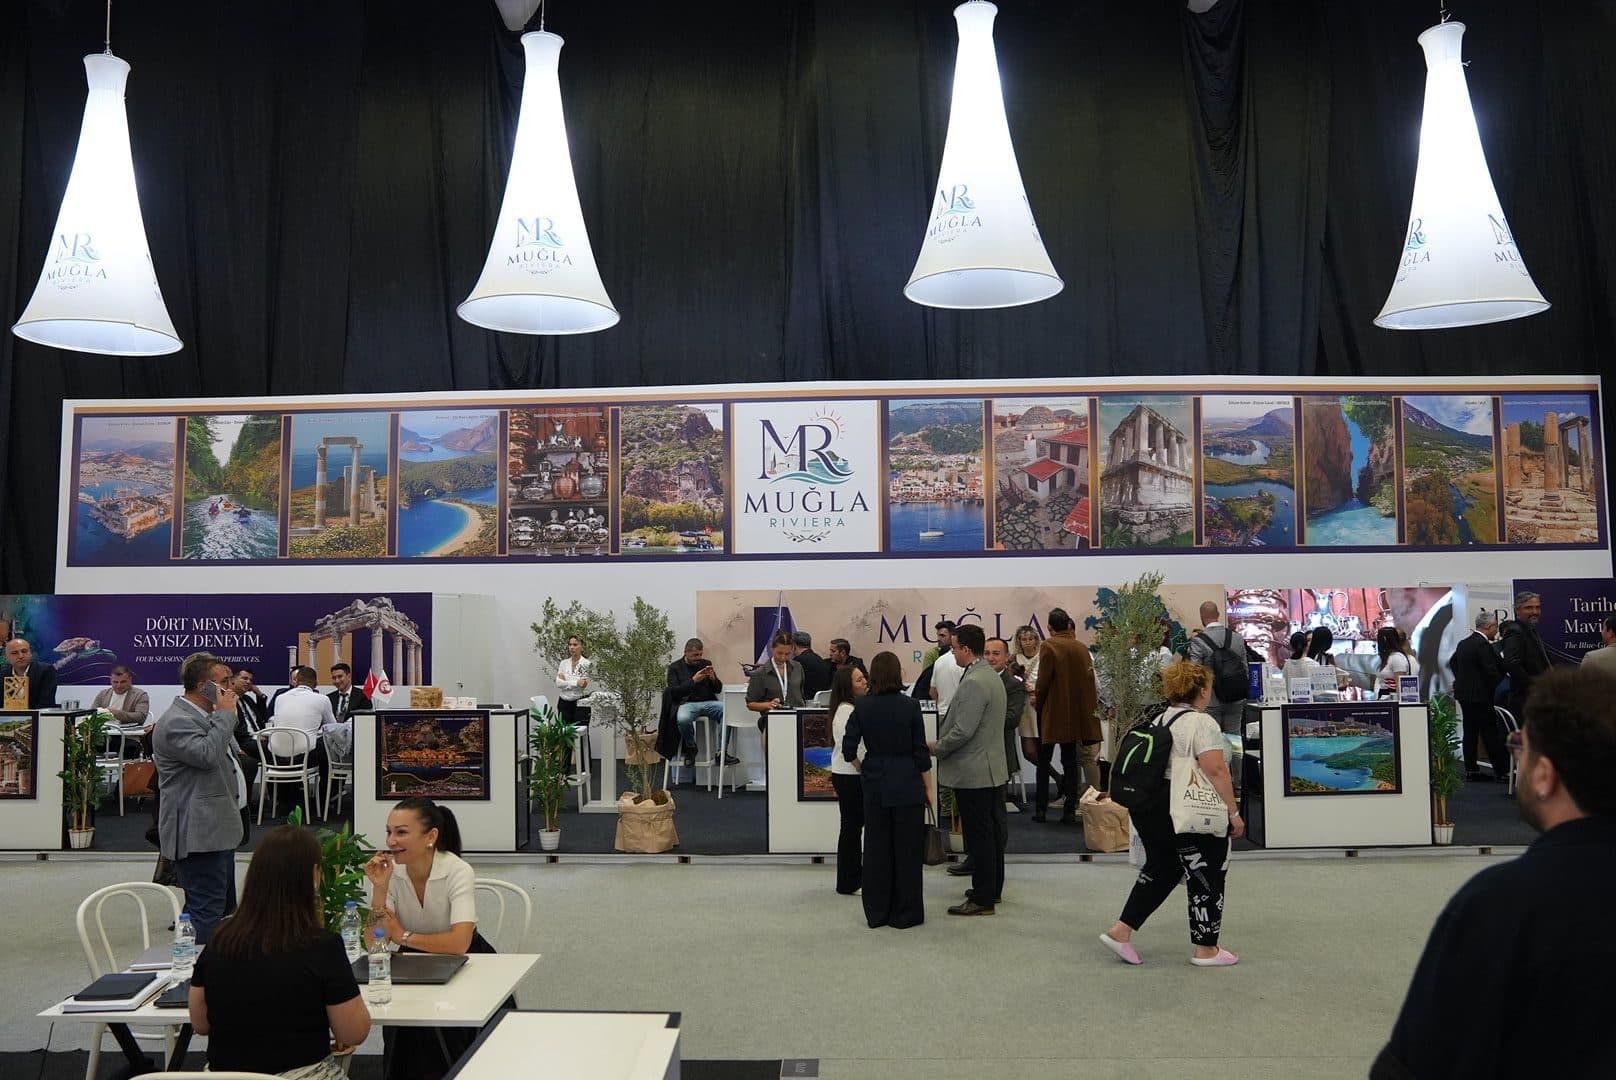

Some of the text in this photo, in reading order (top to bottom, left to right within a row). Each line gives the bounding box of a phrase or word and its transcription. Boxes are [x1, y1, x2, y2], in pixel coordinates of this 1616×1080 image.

[515, 217, 565, 249] MR
[758, 419, 855, 480] MR
[743, 485, 870, 514] MUĞLA
[769, 517, 846, 528] RIVIERA
[145, 615, 253, 633] DÖRT MEVSİM,
[133, 632, 264, 648] SAYISIZ DENEYİM.
[1183, 789, 1222, 804] ALEGR
